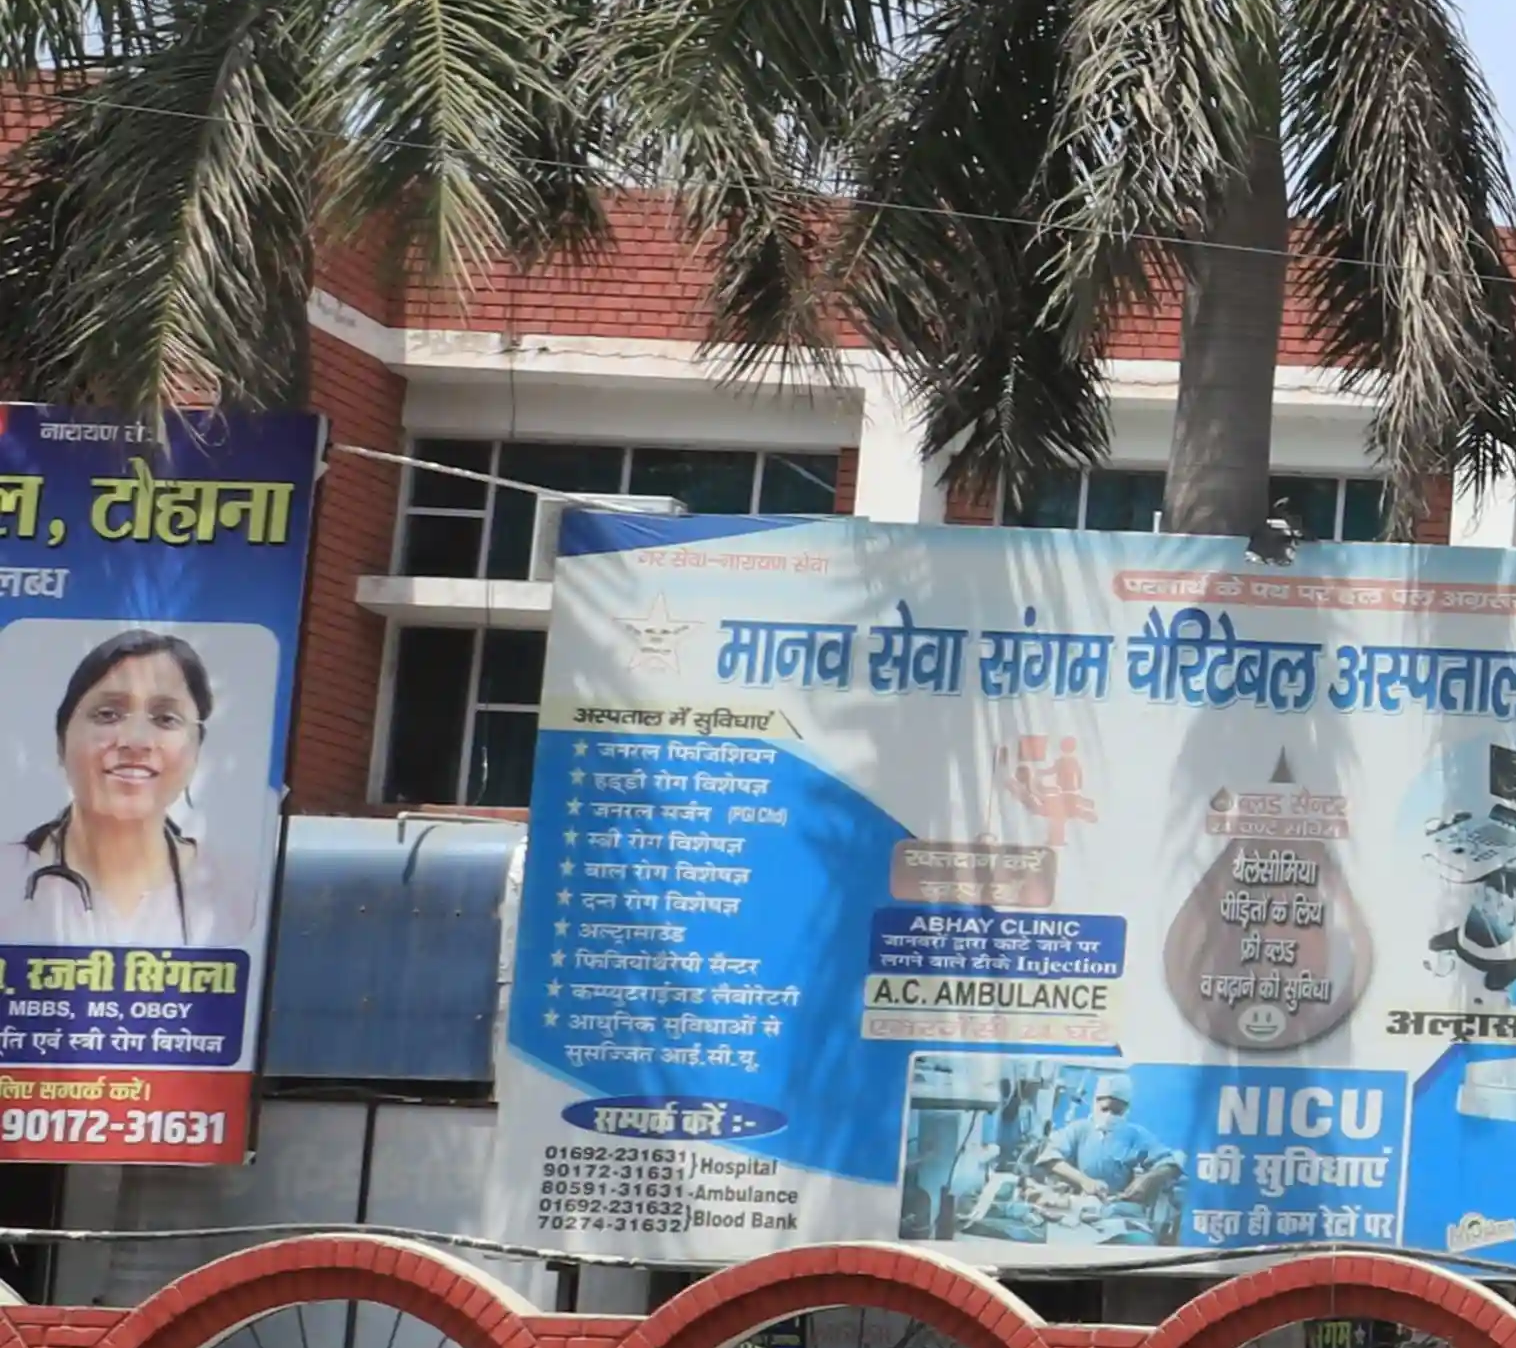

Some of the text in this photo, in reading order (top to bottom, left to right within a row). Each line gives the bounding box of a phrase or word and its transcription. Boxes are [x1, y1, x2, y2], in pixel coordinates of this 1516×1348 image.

[40, 422, 118, 442] नारायण
[90, 457, 294, 545] टोहाना
[717, 619, 858, 691] मानव
[869, 601, 966, 692] सेवा
[978, 606, 1113, 697] संगम
[1127, 606, 1322, 710] चैरिटेबल
[573, 709, 662, 726] अस्पताल
[669, 708, 691, 726] में
[598, 742, 661, 760] जनरल
[633, 859, 669, 881] रोग
[910, 917, 1081, 936] ABHAY CLINIC
[27, 950, 237, 994] रजनी सिंगला
[1017, 958, 1117, 974] Injection
[874, 979, 1108, 1010] A.C. AMBULANCE
[9, 1001, 193, 1020] MBBS, MS, OBGY
[33, 1028, 63, 1054] एवं
[111, 1027, 146, 1052] रोग
[152, 1028, 225, 1053] विशेषज्ञ
[40, 1076, 105, 1099] सम्पर्क
[594, 1102, 727, 1135] सम्पर्क करें
[1217, 1085, 1383, 1139] NICU
[2, 1108, 225, 1144] 90172-31631
[544, 1163, 684, 1180] 90172-31631
[545, 1146, 777, 1178] 01692-231631 Hospital
[1197, 1145, 1393, 1198] की सुविधाएं
[542, 1181, 683, 1198] 80591-31631
[538, 1216, 682, 1233] 70274-31632
[539, 1199, 798, 1230] 01692-231632 Blood Bank
[1192, 1209, 1243, 1244] बहुत
[1248, 1203, 1272, 1236] ही
[1277, 1212, 1317, 1236] कम
[1364, 1213, 1394, 1239] पर
